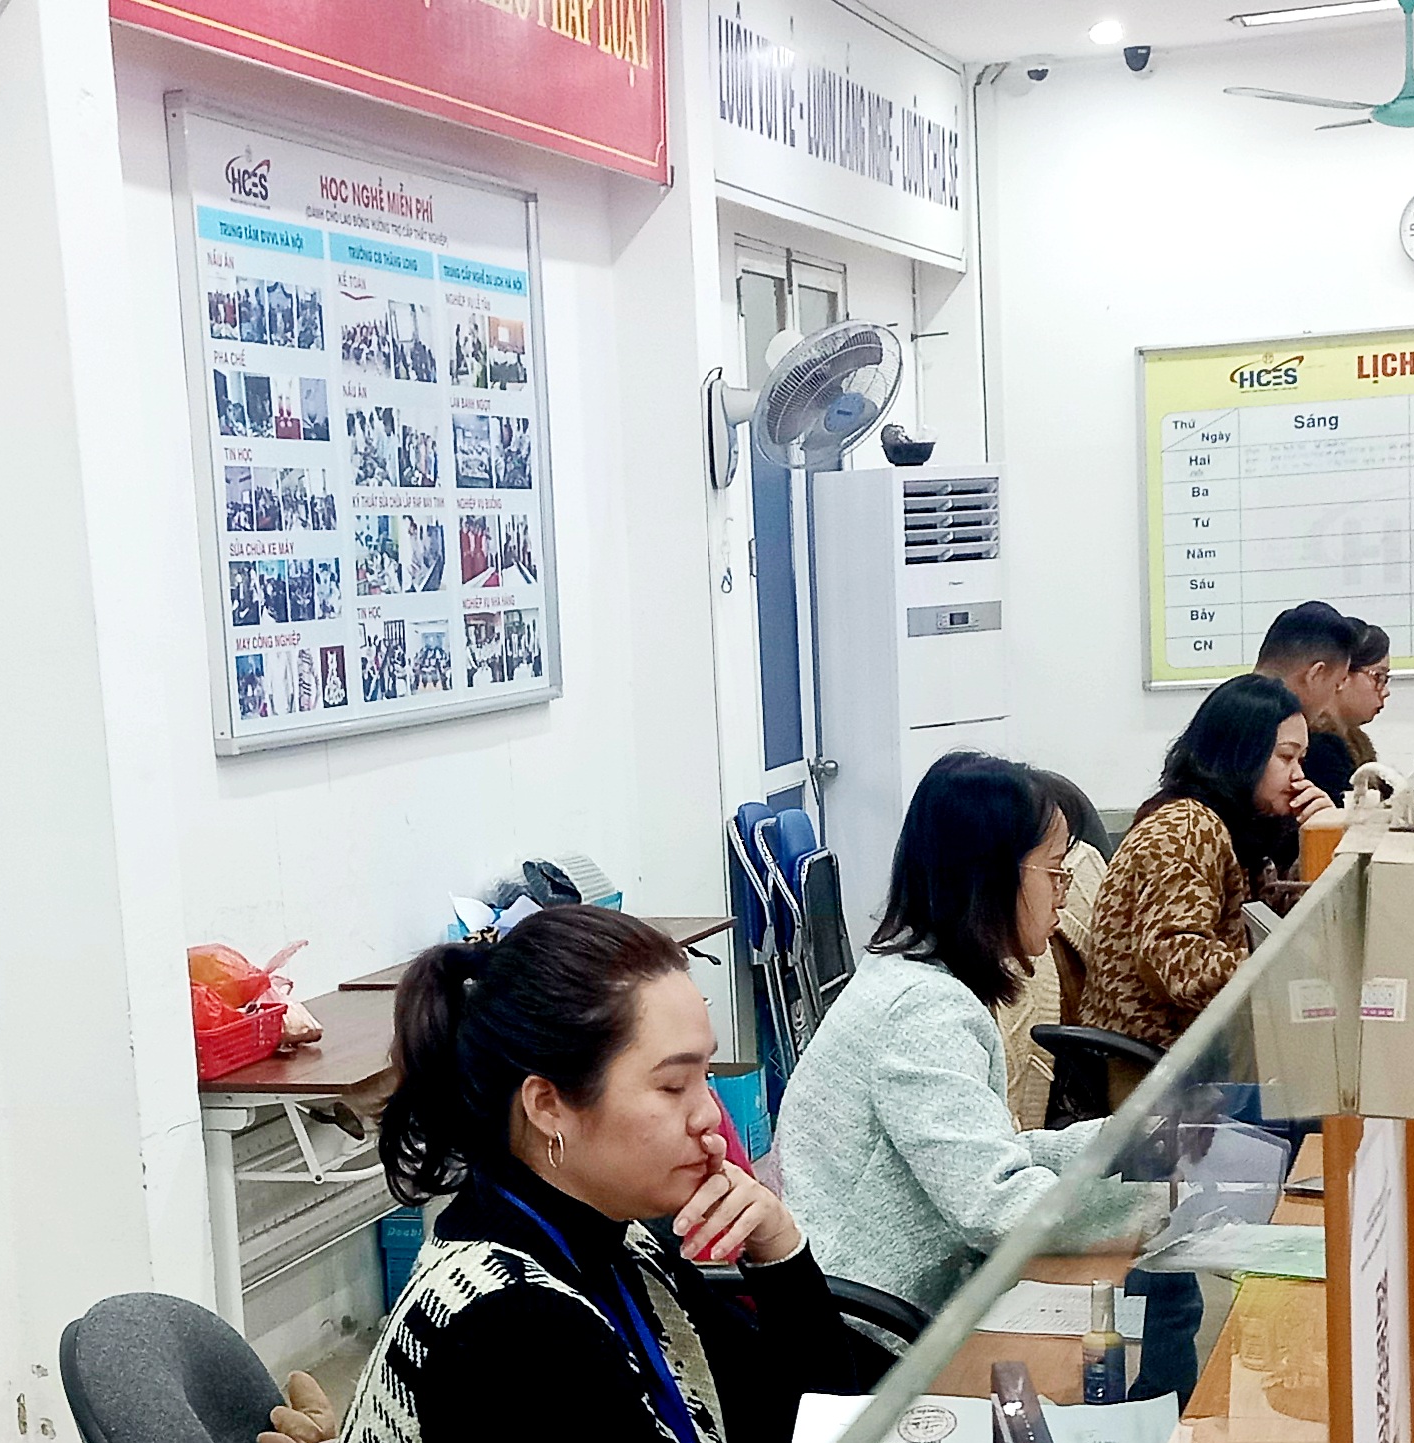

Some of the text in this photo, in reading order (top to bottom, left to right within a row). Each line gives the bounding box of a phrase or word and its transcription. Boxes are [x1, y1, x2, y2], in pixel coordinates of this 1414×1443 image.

[320, 175, 348, 209] HỌC
[351, 176, 385, 212] NGHỀ
[415, 195, 433, 223] PHÍ
[1238, 367, 1297, 390] HCES
[1171, 416, 1197, 432] Thứ
[1292, 411, 1340, 434] Sáng
[1201, 428, 1232, 444] Ngày
[1189, 453, 1211, 467] Hai
[1191, 486, 1210, 498] Ba
[1192, 516, 1211, 528] Tư
[1186, 548, 1217, 560] Năm
[1189, 579, 1215, 591] Sáu
[1190, 608, 1215, 623] Bảy
[1193, 640, 1214, 652] CN
